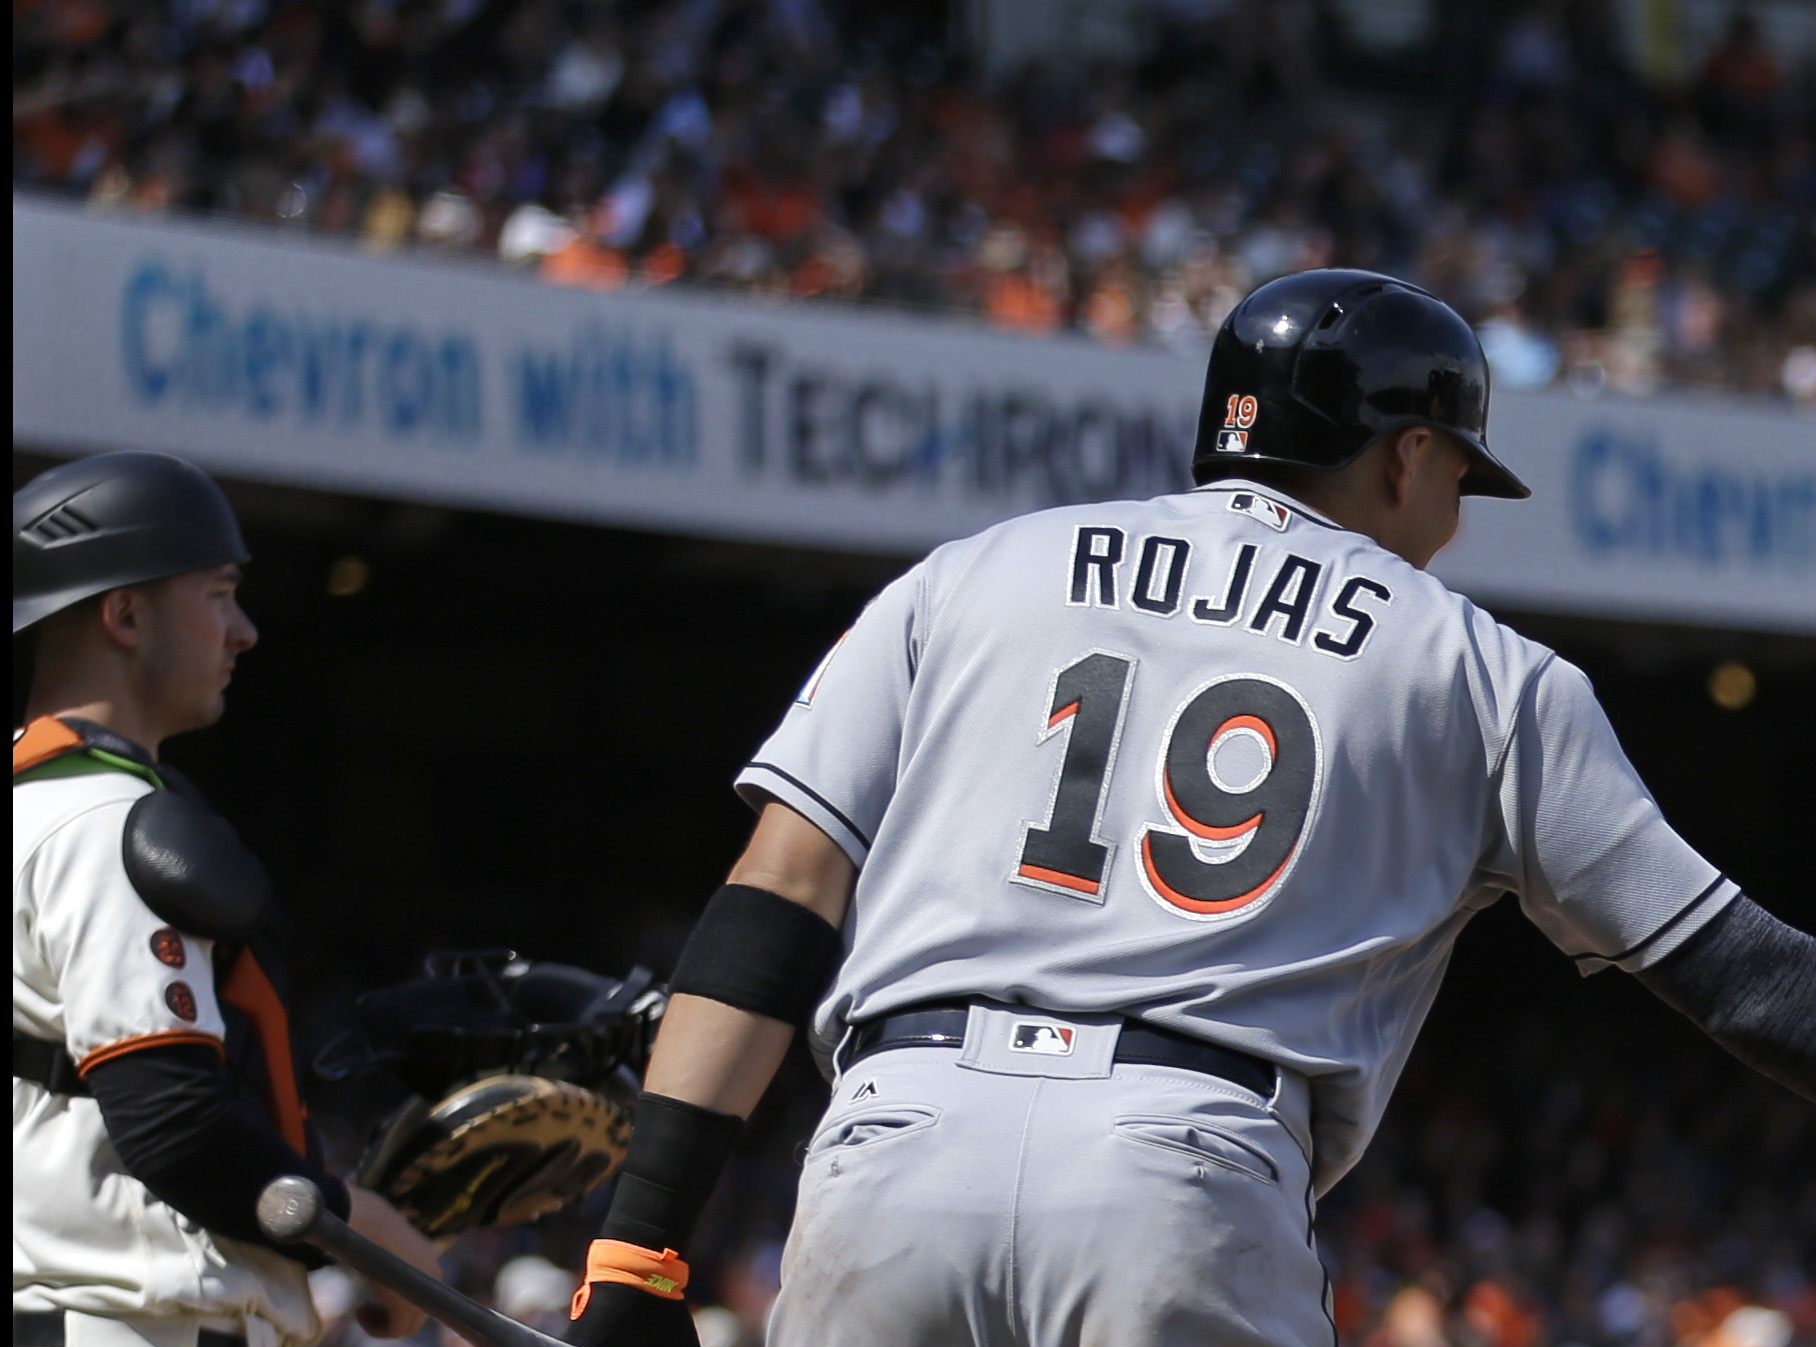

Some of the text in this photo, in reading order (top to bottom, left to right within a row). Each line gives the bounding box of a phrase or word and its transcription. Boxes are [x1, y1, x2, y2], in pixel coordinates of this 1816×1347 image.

[118, 258, 487, 445] Chevron
[515, 318, 700, 470] with
[1224, 394, 1258, 428] 19
[1065, 524, 1392, 662] ROJAS
[1008, 647, 1325, 922] 19
[644, 1273, 679, 1293] NIKE
